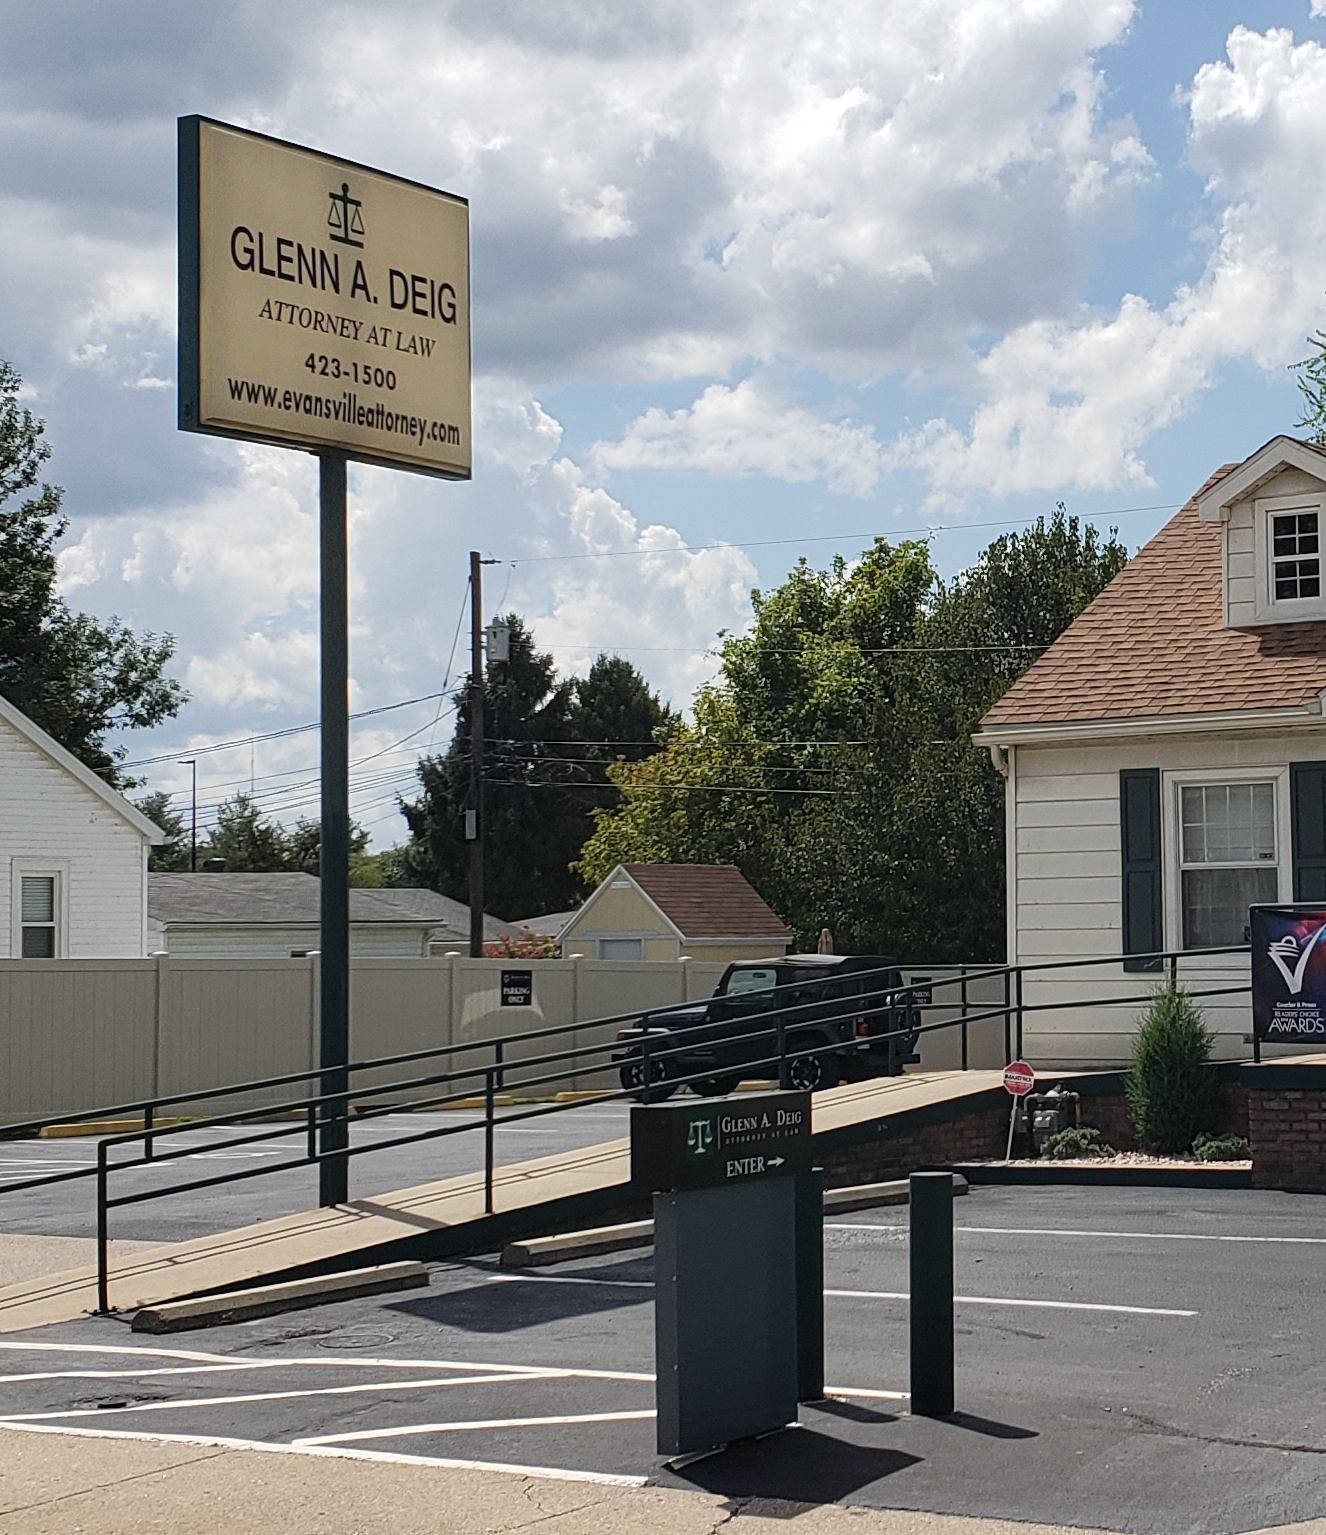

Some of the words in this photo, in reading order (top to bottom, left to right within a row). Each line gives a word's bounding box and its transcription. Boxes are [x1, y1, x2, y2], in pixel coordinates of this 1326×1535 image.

[231, 226, 340, 295] GLENN
[350, 260, 378, 304] A.
[389, 268, 457, 325] DEIG
[258, 298, 364, 340] ATTORNEY
[366, 325, 392, 347] AT
[395, 331, 436, 358] LAW
[305, 353, 397, 390] 423-1500
[228, 378, 460, 446] www.evansvilleattorney.com
[1268, 1017, 1325, 1033] AWARDS
[721, 1116, 758, 1133] GLENN
[777, 1109, 802, 1126] DEIG
[727, 1156, 766, 1178] ENTER
